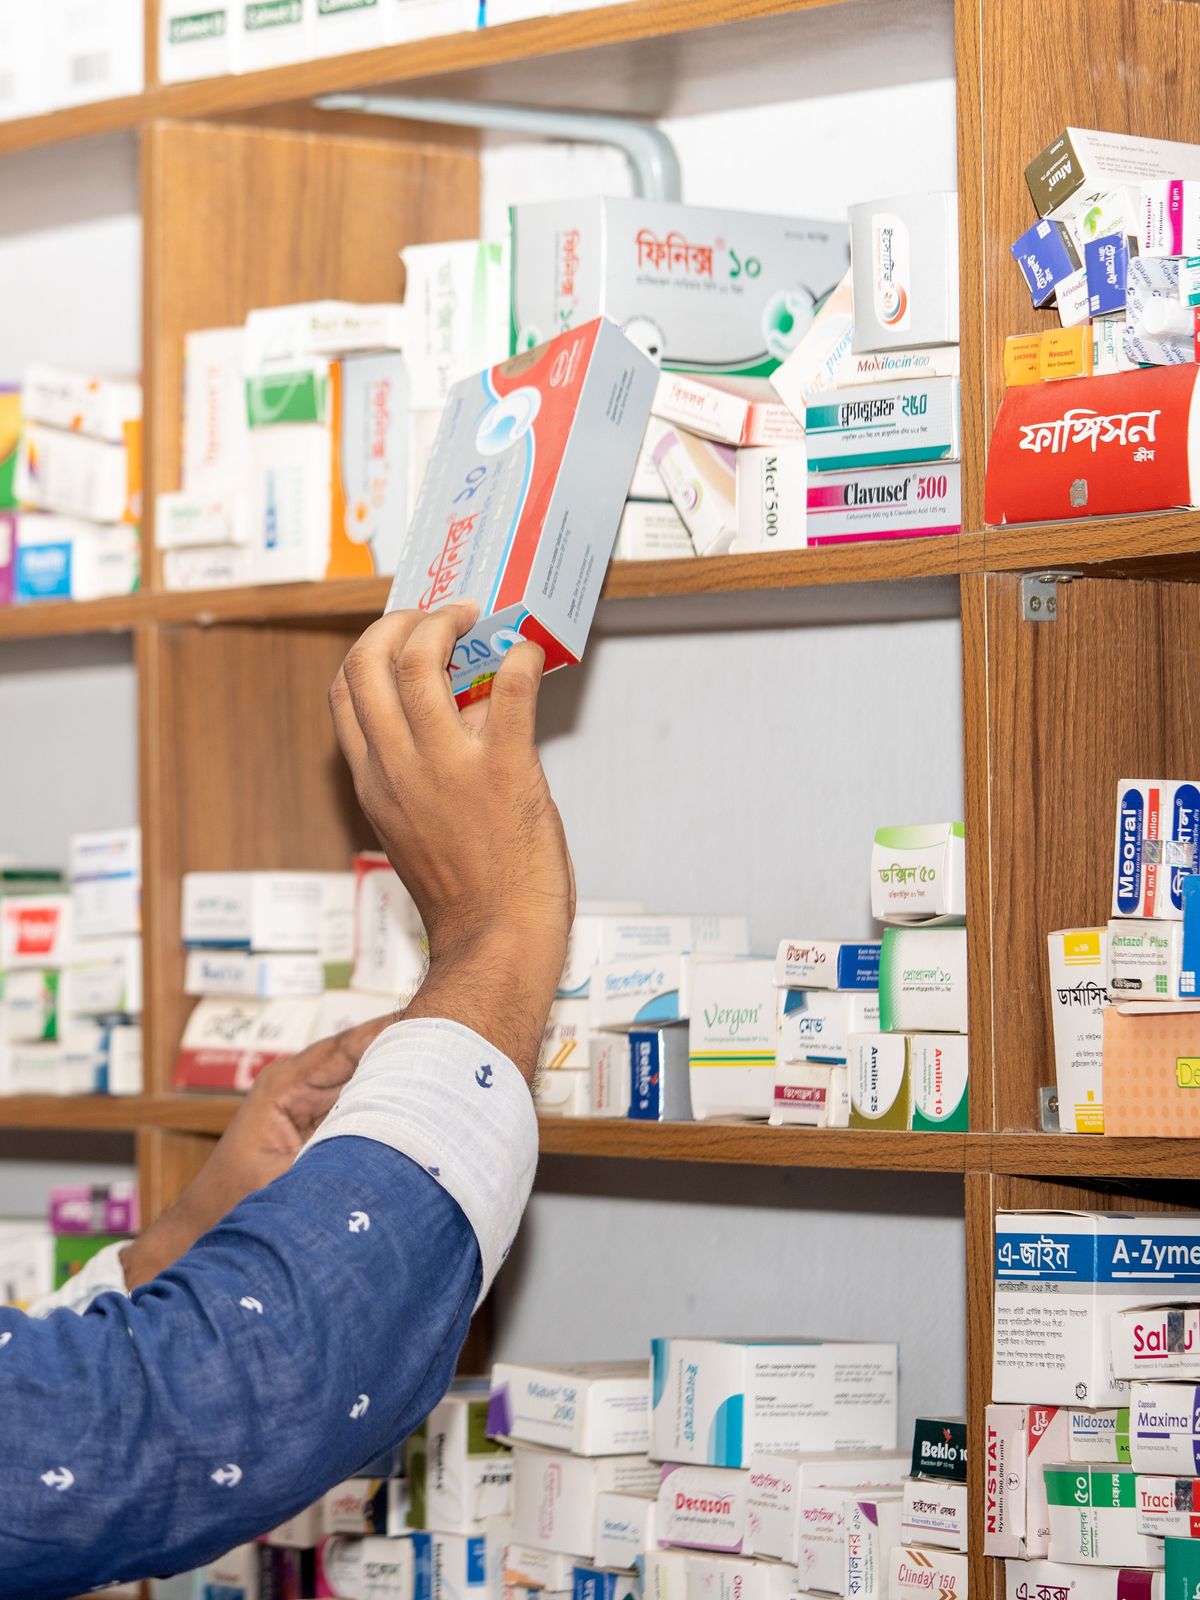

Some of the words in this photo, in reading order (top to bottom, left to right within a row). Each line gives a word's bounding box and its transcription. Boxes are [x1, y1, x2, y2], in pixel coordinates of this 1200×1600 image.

[1049, 160, 1072, 187] Afun
[1172, 187, 1179, 199] gm
[1172, 201, 1179, 211] 10
[636, 228, 714, 278] ফিনিক্স
[729, 249, 762, 278] ১০
[825, 324, 854, 376] sotid
[1049, 349, 1073, 359] Neocort
[857, 356, 912, 372] Moxilocin
[913, 356, 930, 366] 400
[902, 394, 928, 416] ২৫০
[1019, 408, 1161, 453] ফাঙ্গিসন
[1133, 447, 1155, 462] ক্রীম
[453, 466, 487, 504] ২০
[765, 456, 778, 492] Met
[844, 477, 911, 506] Clavusef
[917, 475, 947, 500] 500
[765, 500, 779, 538] 500
[456, 639, 490, 664] 20
[1119, 809, 1137, 898] Meoral
[920, 866, 935, 882] ৫০
[1148, 876, 1154, 888] ml
[1112, 935, 1143, 947] Antazol
[1150, 936, 1168, 948] Plus
[940, 971, 951, 982] ১০
[704, 1003, 759, 1035] Vergon
[639, 1041, 651, 1096] Beklo
[870, 1046, 878, 1090] Amilin
[935, 1048, 943, 1092] Amilin
[870, 1096, 878, 1112] 25
[935, 1099, 943, 1115] 10
[998, 1234, 1070, 1270] এ-জাইম
[1112, 1238, 1200, 1271] A-Zyme
[1134, 1324, 1193, 1352] Salu
[1110, 1380, 1124, 1392] Mfg.
[1138, 1400, 1157, 1409] Capsule
[1073, 1415, 1115, 1429] Nidozox
[1138, 1413, 1188, 1428] Maxima
[921, 1441, 957, 1461] Beklo
[987, 1425, 998, 1534] NYSTAT
[1074, 1476, 1089, 1504] ৫০
[1112, 1473, 1121, 1507] একমি
[675, 1493, 731, 1515] Decason
[913, 1500, 937, 1514] হাইপেন
[1141, 1492, 1177, 1508] Traci
[899, 1564, 936, 1590] ClindaX
[939, 1574, 956, 1590] 150
